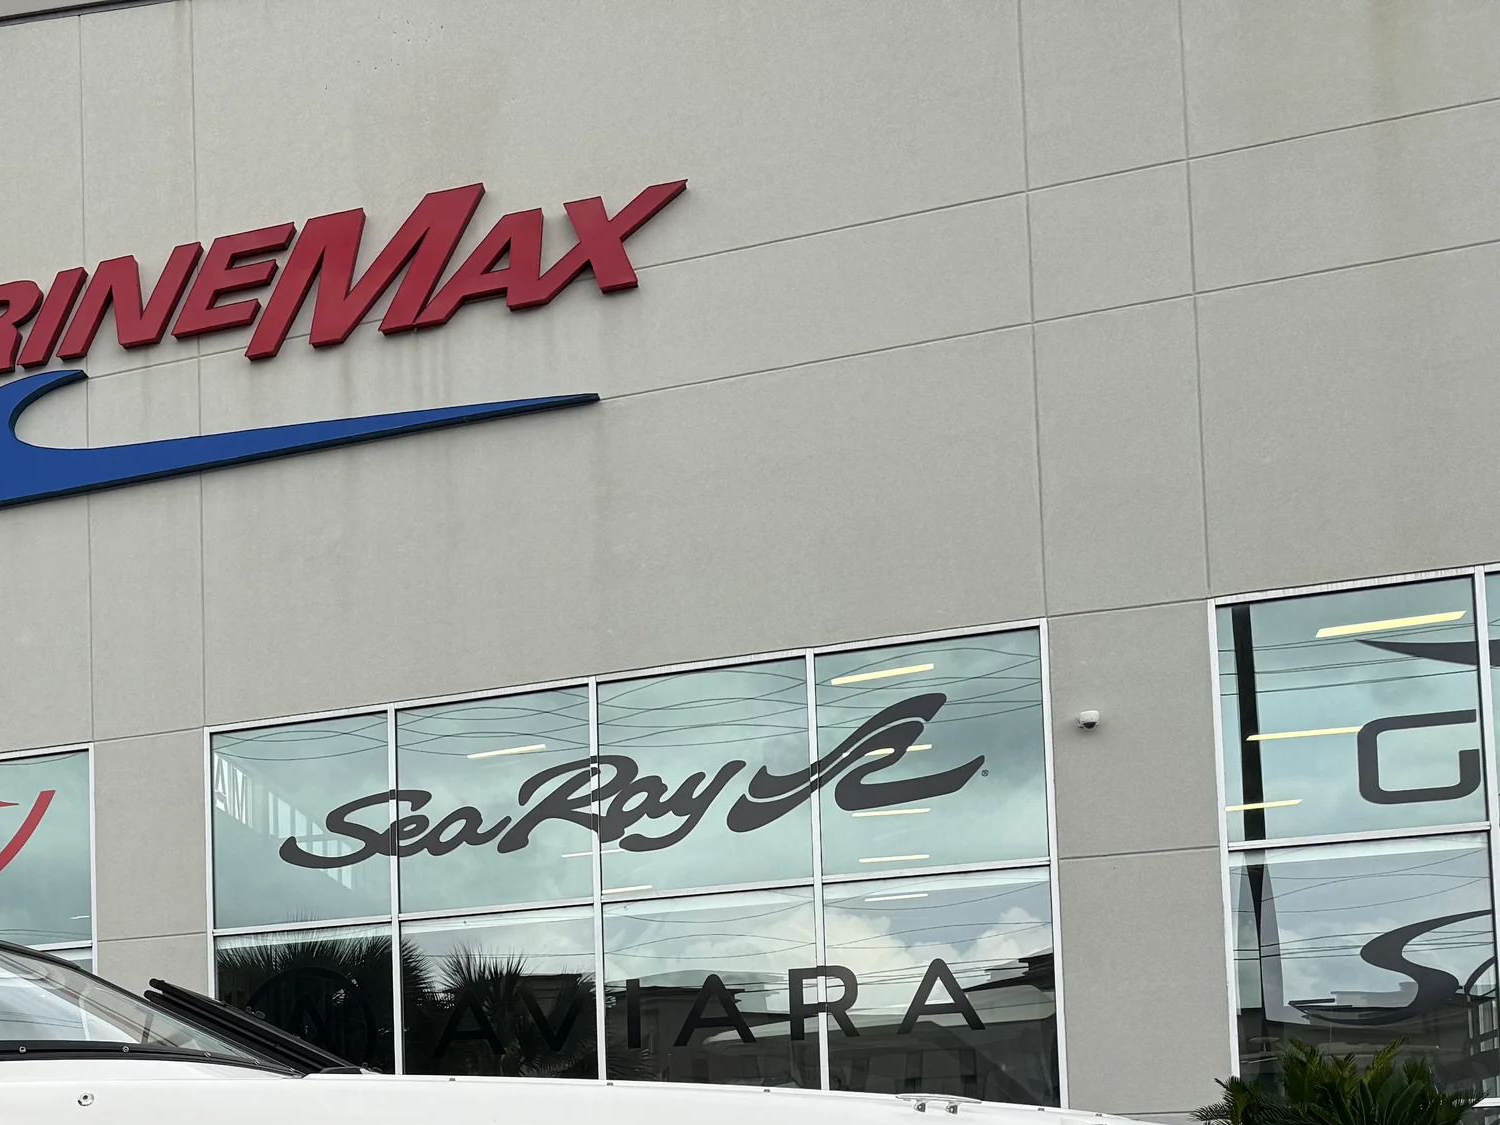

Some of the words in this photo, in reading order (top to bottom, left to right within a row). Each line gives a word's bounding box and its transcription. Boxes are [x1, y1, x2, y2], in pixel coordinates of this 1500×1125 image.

[279, 789, 510, 870] Sea
[497, 754, 746, 853] Ray
[433, 958, 986, 1058] AVIARA
